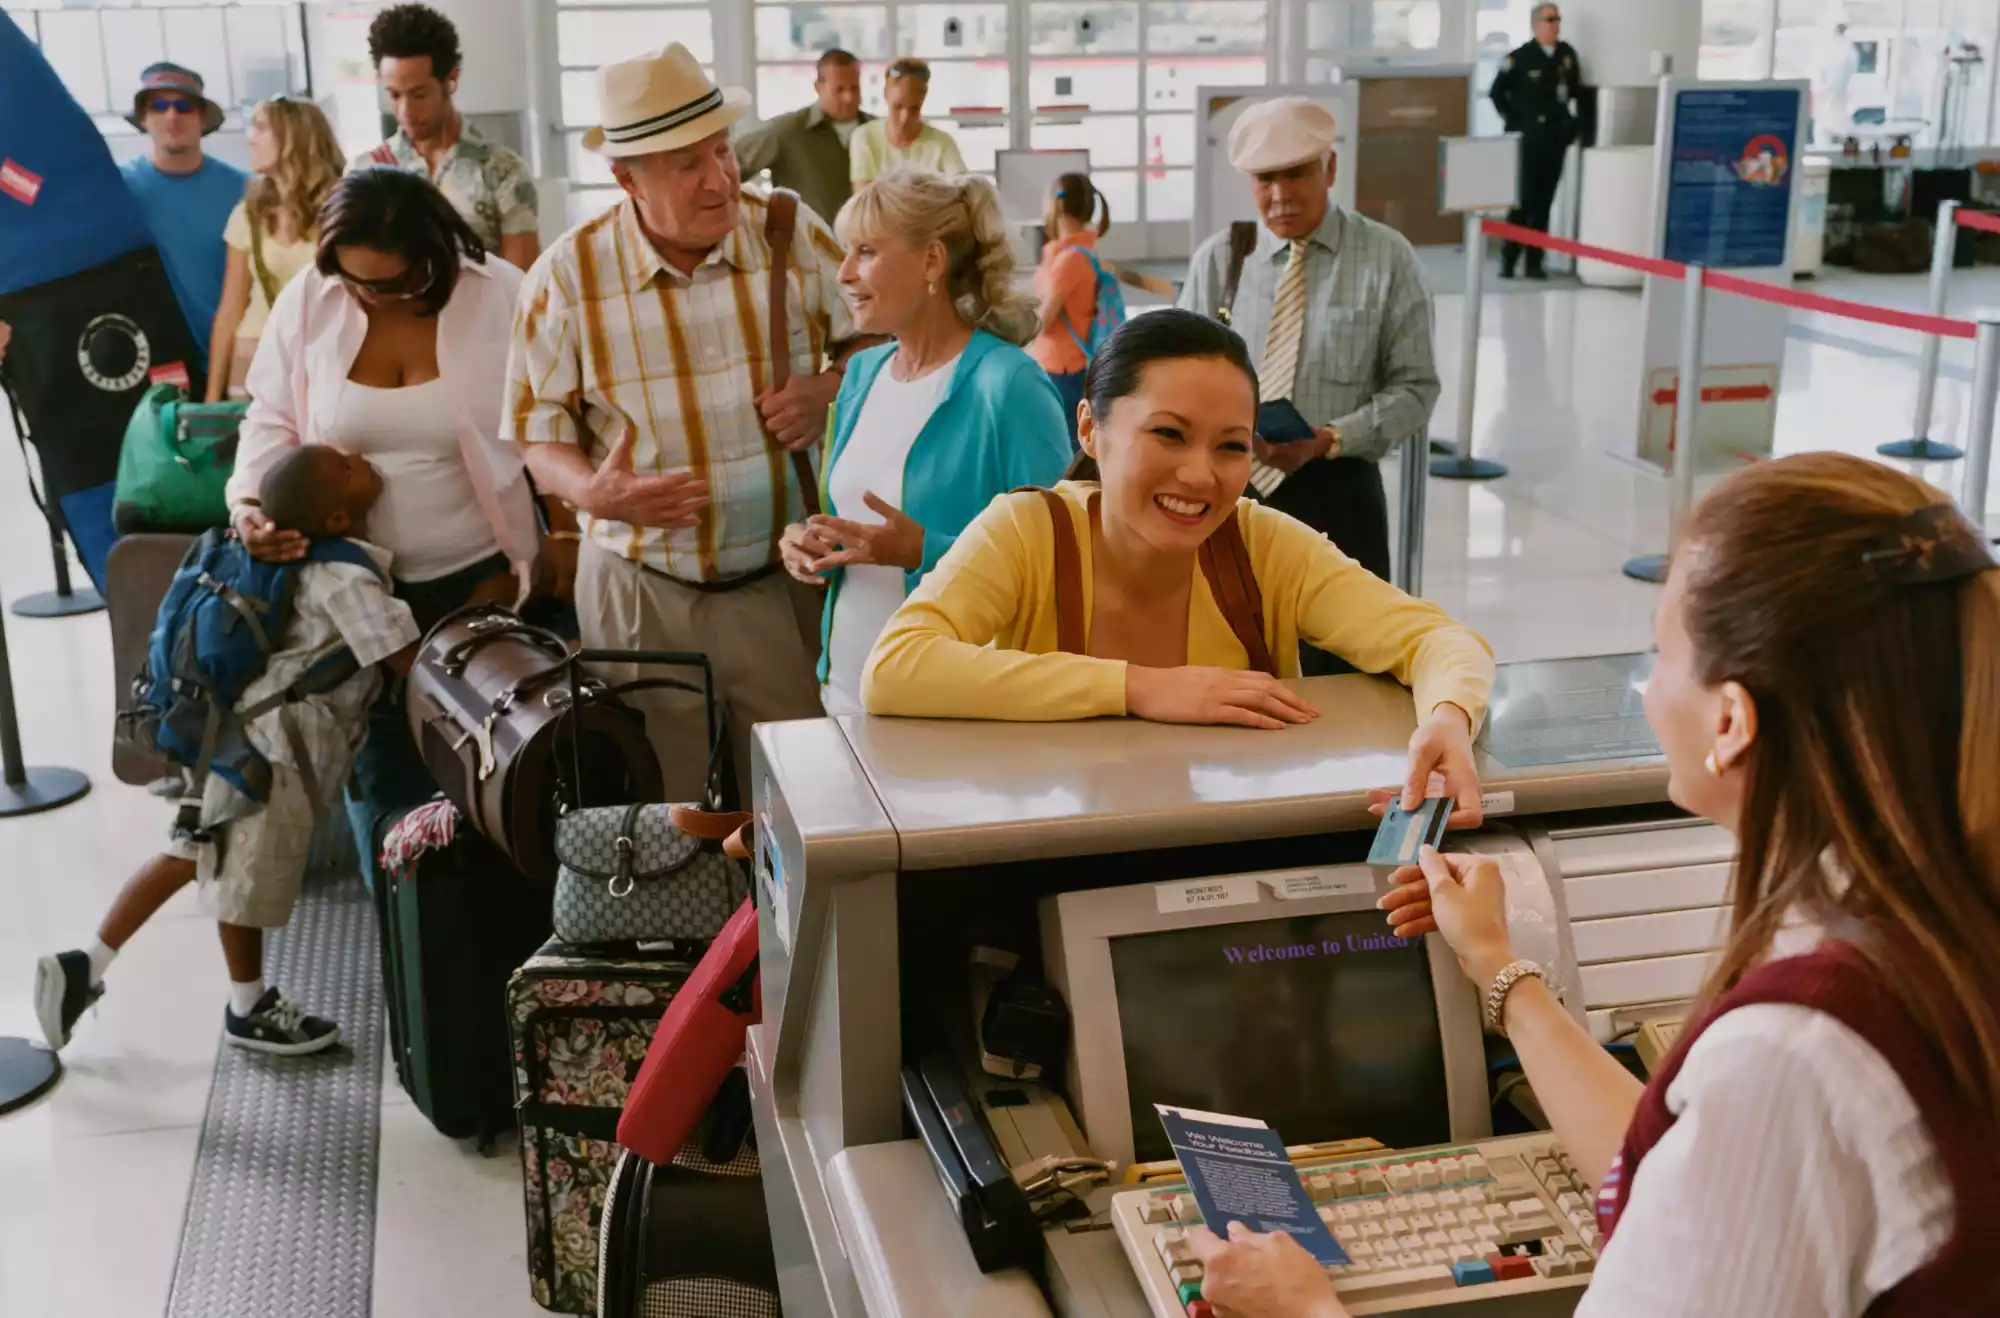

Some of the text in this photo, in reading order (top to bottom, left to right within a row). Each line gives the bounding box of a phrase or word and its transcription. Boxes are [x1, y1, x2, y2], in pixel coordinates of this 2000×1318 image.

[1222, 942, 1316, 964] Welcome
[1321, 939, 1341, 955] to
[1345, 932, 1408, 953] United
[1184, 1130, 1265, 1150] We Welcome
[1188, 1138, 1279, 1159] Your Feedback
